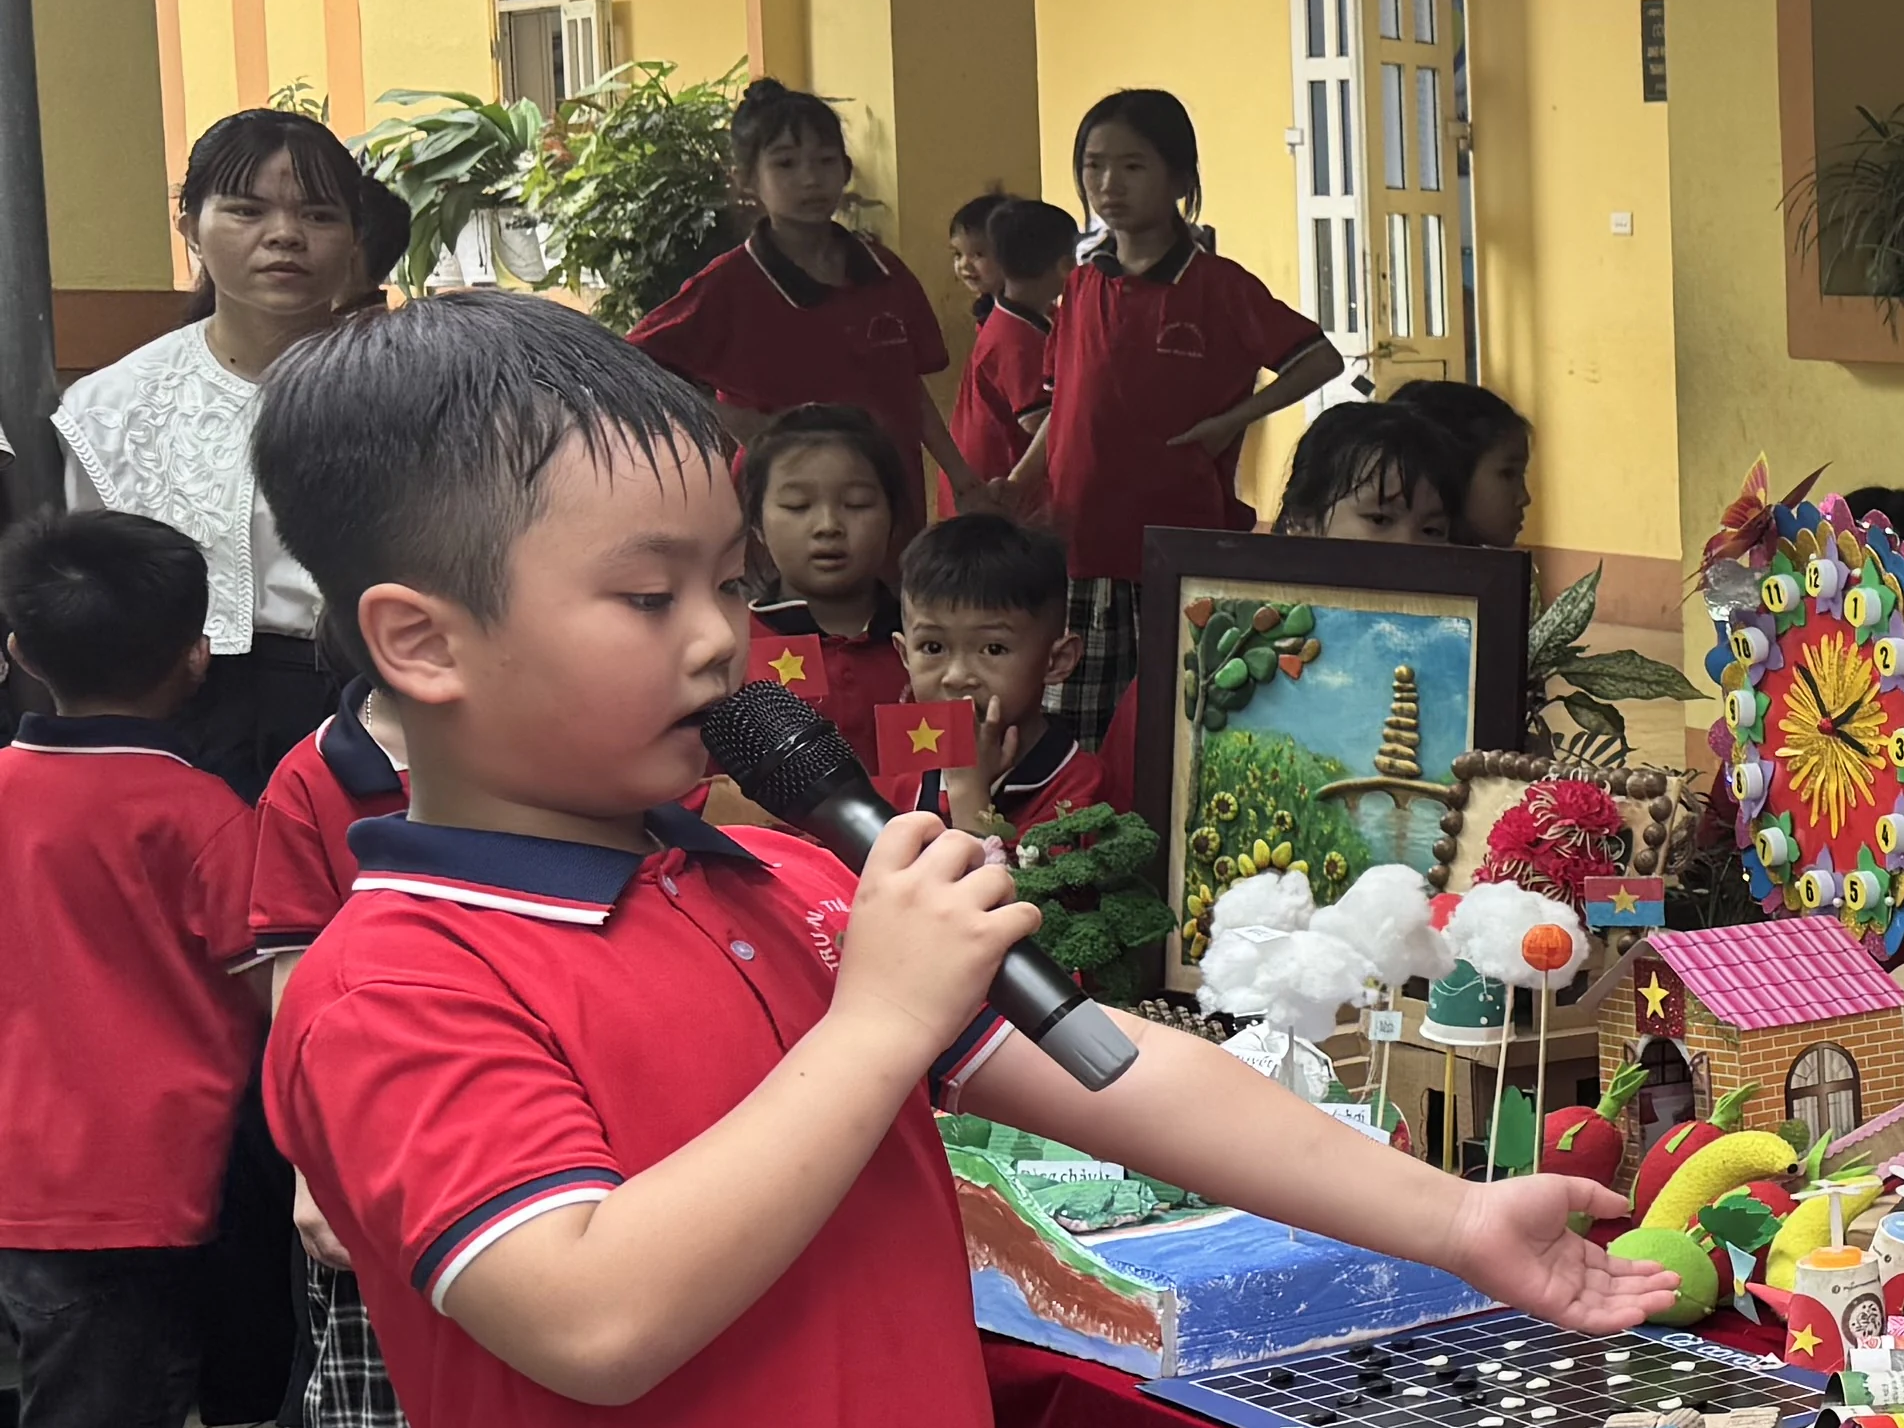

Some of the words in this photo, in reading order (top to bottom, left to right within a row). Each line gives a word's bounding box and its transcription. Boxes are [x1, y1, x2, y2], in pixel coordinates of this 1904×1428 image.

[1766, 583, 1781, 607] 11
[1852, 597, 1858, 619] 1
[1880, 647, 1891, 670] 2
[1895, 737, 1904, 761] 3
[1881, 824, 1889, 846] 4
[1760, 839, 1767, 859] 7
[1805, 879, 1814, 902] 6
[1849, 880, 1858, 903] 5
